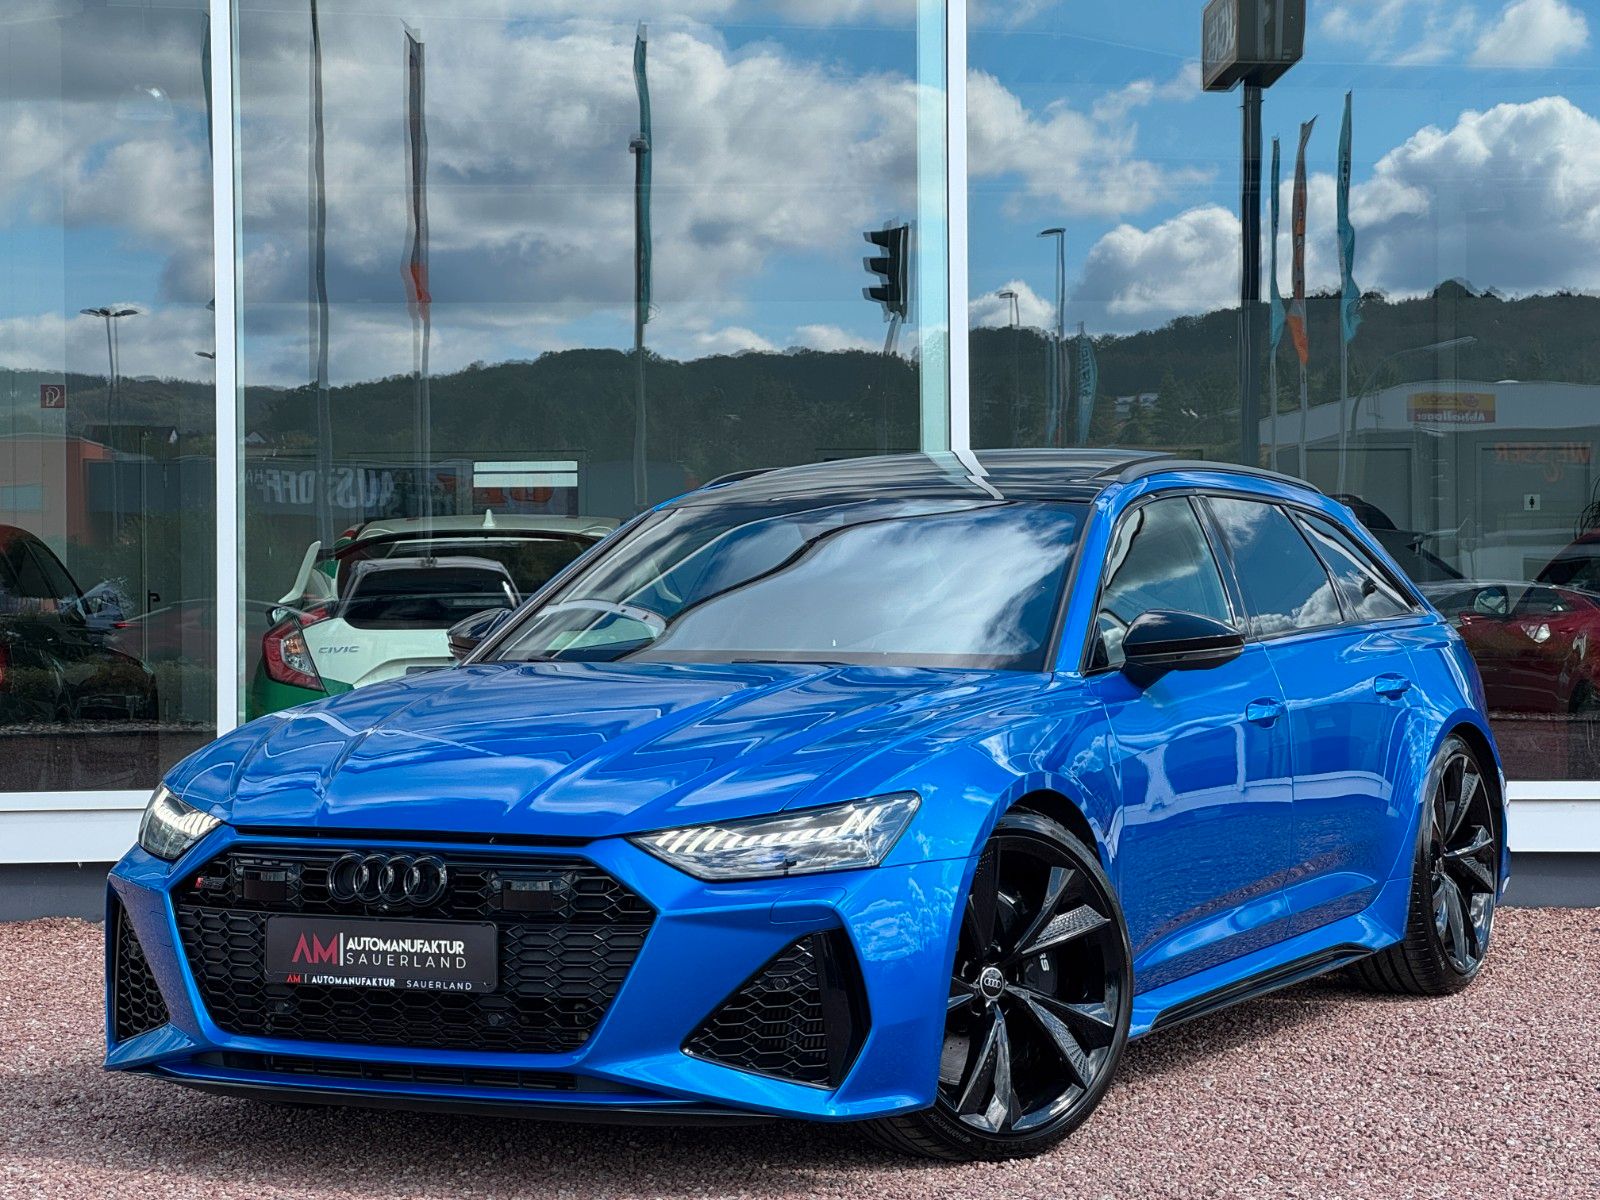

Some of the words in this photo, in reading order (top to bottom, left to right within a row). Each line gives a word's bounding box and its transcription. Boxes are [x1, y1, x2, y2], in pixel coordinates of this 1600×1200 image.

[318, 645, 360, 654] CIVIC
[292, 931, 338, 965] AM
[346, 937, 464, 954] AUTOMANUFAKTUR
[346, 952, 467, 969] SAUERLAND
[287, 974, 301, 984] AM
[311, 974, 396, 988] AUTOMANUFAKTUR
[405, 980, 473, 991] SAUERLAND
